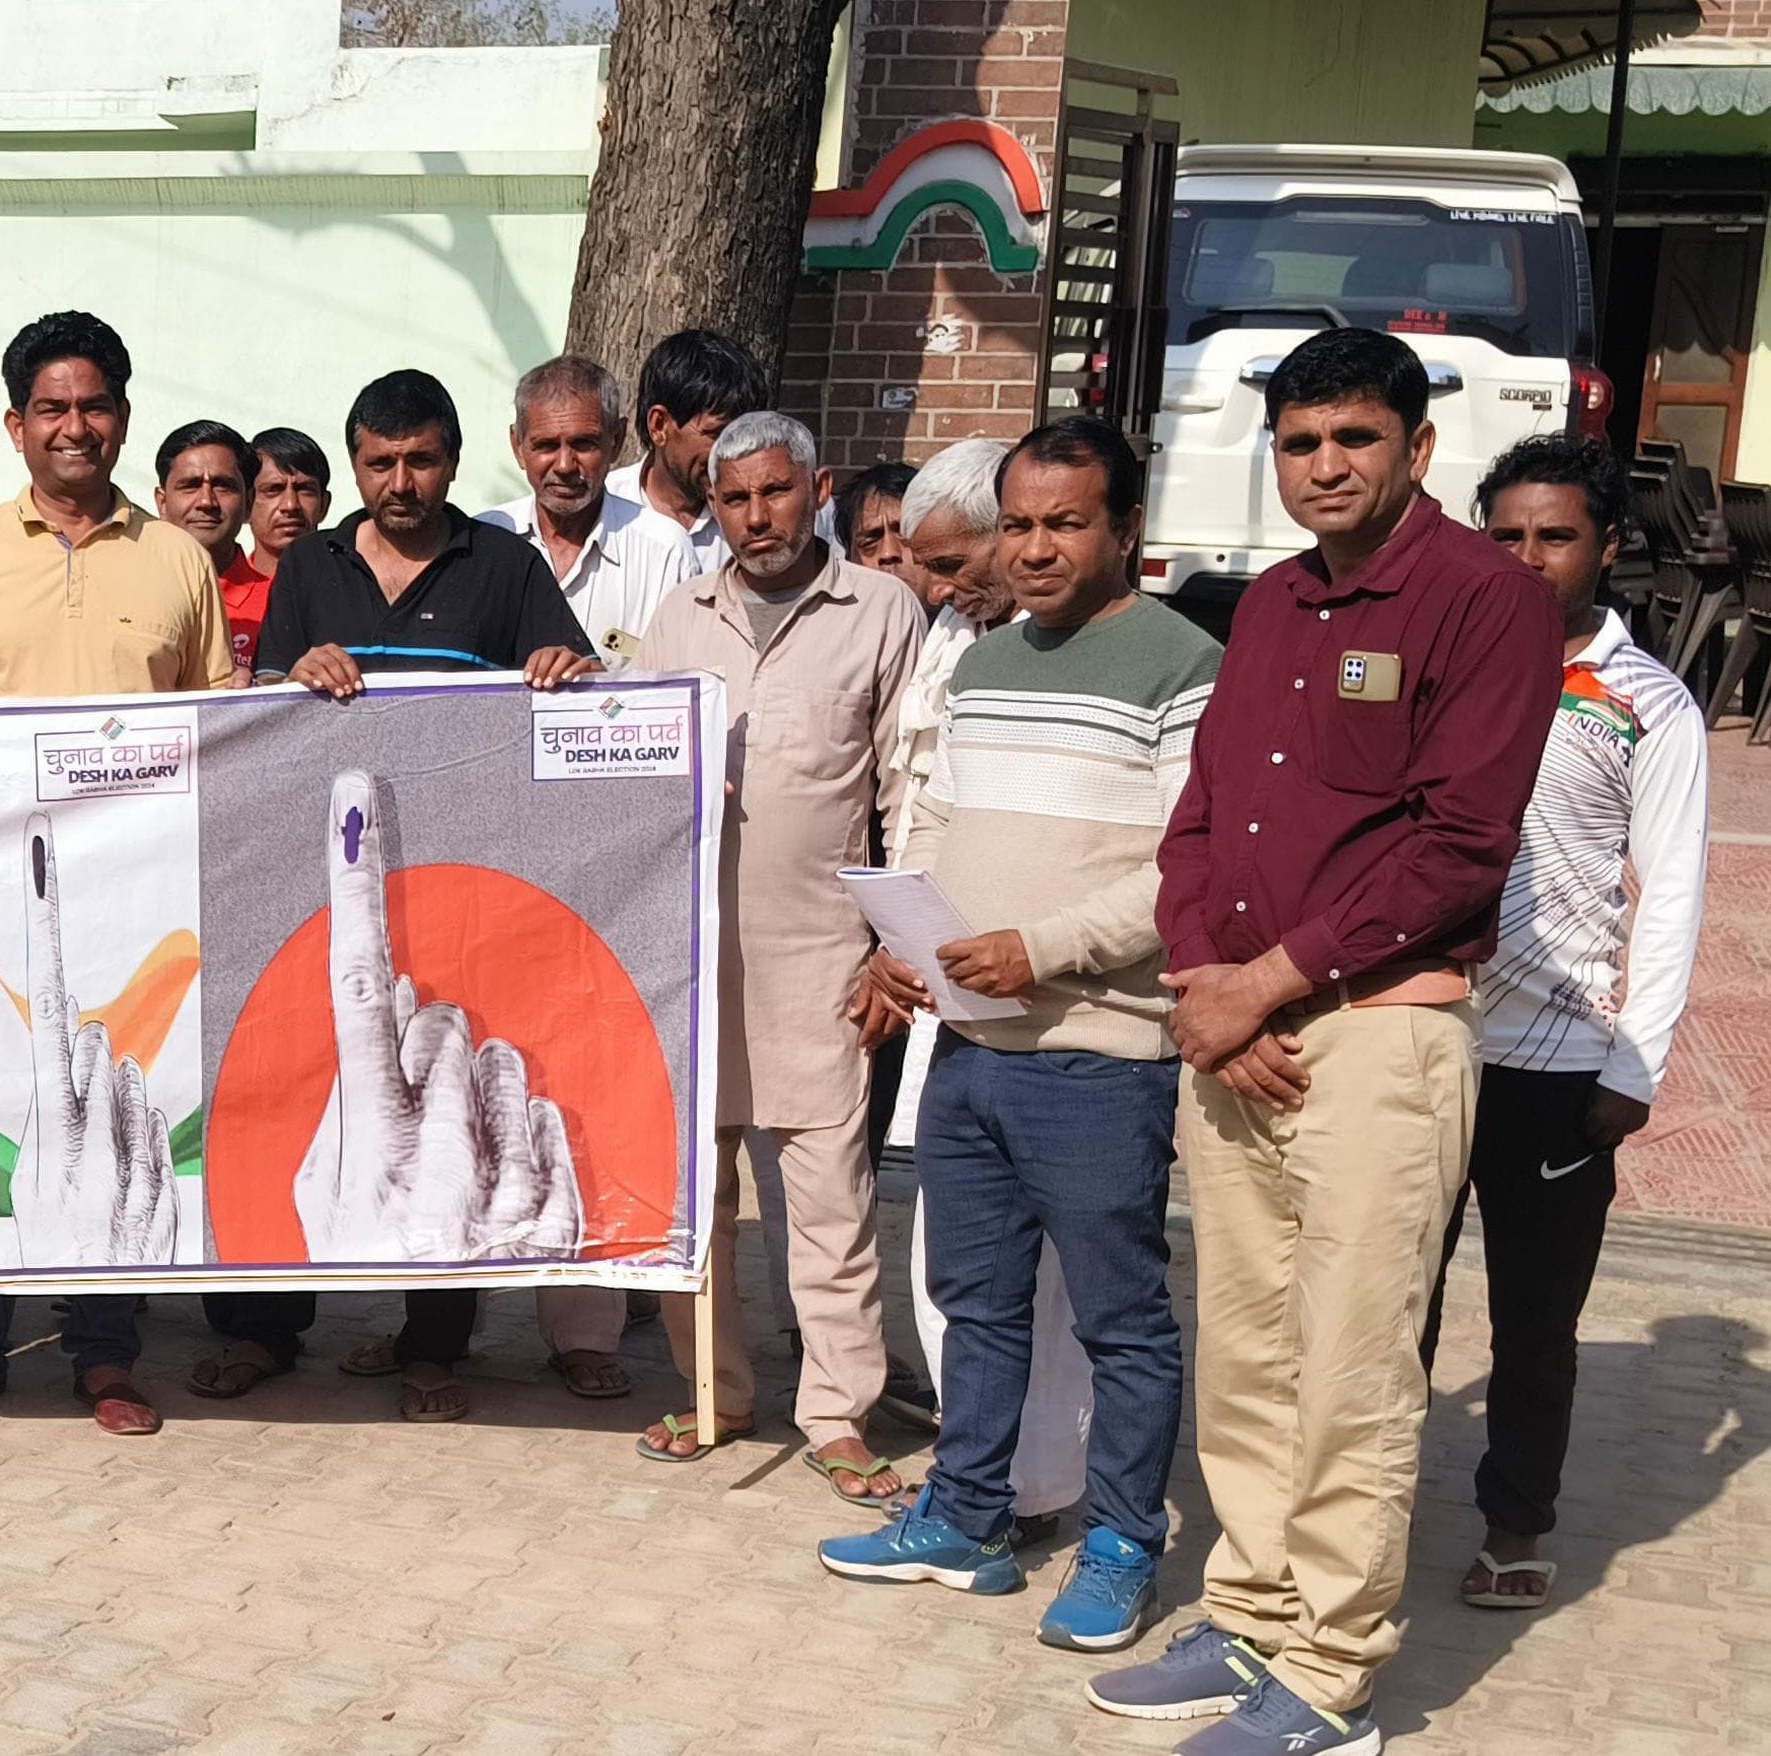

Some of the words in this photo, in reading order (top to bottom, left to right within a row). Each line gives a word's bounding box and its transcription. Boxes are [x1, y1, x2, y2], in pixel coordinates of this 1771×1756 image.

[1499, 388, 1552, 403] SCORPIO
[540, 725, 603, 754] चुनाव
[608, 725, 642, 744] का
[646, 715, 684, 744] पर्व
[1568, 712, 1619, 750] INDIA
[43, 747, 104, 775] चुनाव
[110, 744, 145, 764] का
[147, 735, 184, 763] पर्व
[565, 747, 606, 763] DESH
[609, 747, 632, 762] KA
[635, 746, 680, 761] GARV
[68, 769, 108, 784] DESH
[111, 767, 133, 782] KA
[135, 764, 180, 779] GARV
